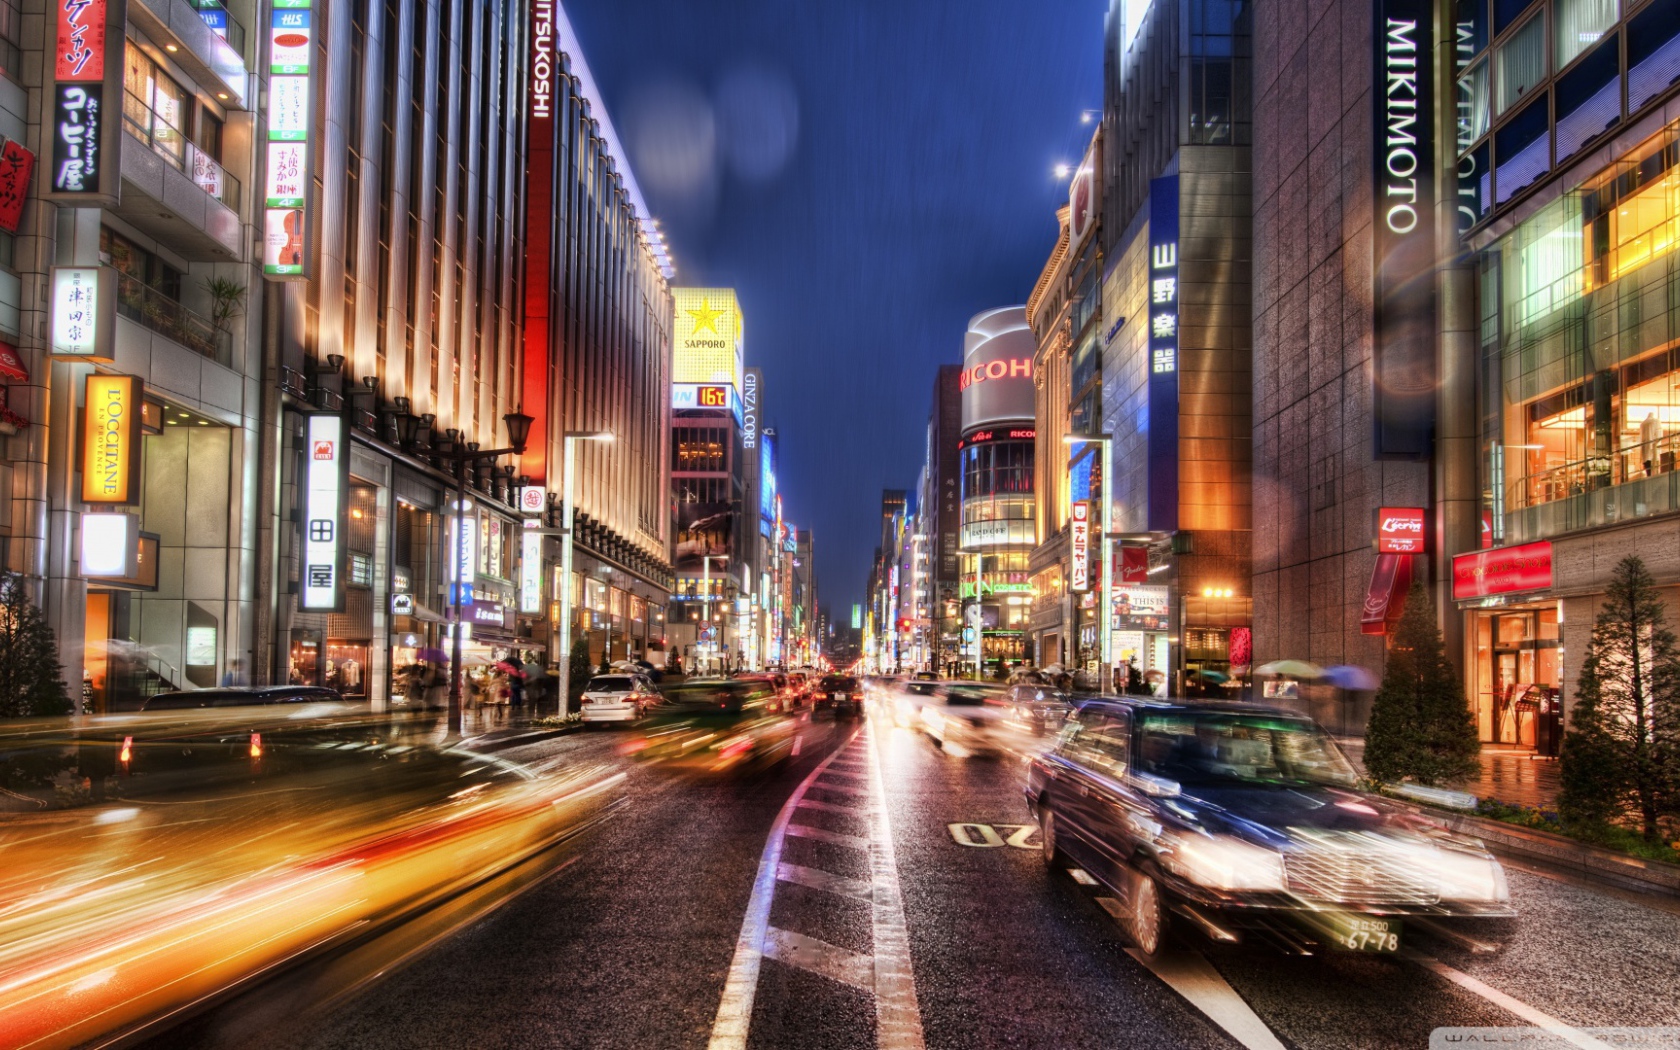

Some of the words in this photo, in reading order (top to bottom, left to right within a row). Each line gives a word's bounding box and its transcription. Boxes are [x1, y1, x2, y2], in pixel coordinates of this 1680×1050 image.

[57, 87, 87, 191] コーヒー屋
[1387, 18, 1417, 234] MIKIMOTO
[1153, 243, 1176, 373] 山野楽器
[684, 339, 726, 349] SAPPORO
[744, 373, 756, 415] GINZA
[959, 358, 1031, 392] RICOH
[98, 408, 105, 420] EN
[743, 415, 756, 449] CORE
[96, 425, 104, 475] PROVENCE
[104, 389, 123, 494] L'OCCITANE
[308, 519, 334, 588] 田屋
[1074, 526, 1085, 586] キムラヤのパン
[1133, 597, 1155, 605] THIS
[1156, 597, 1164, 605] IS
[1348, 931, 1399, 952] 67-78
[1370, 921, 1389, 932] 500
